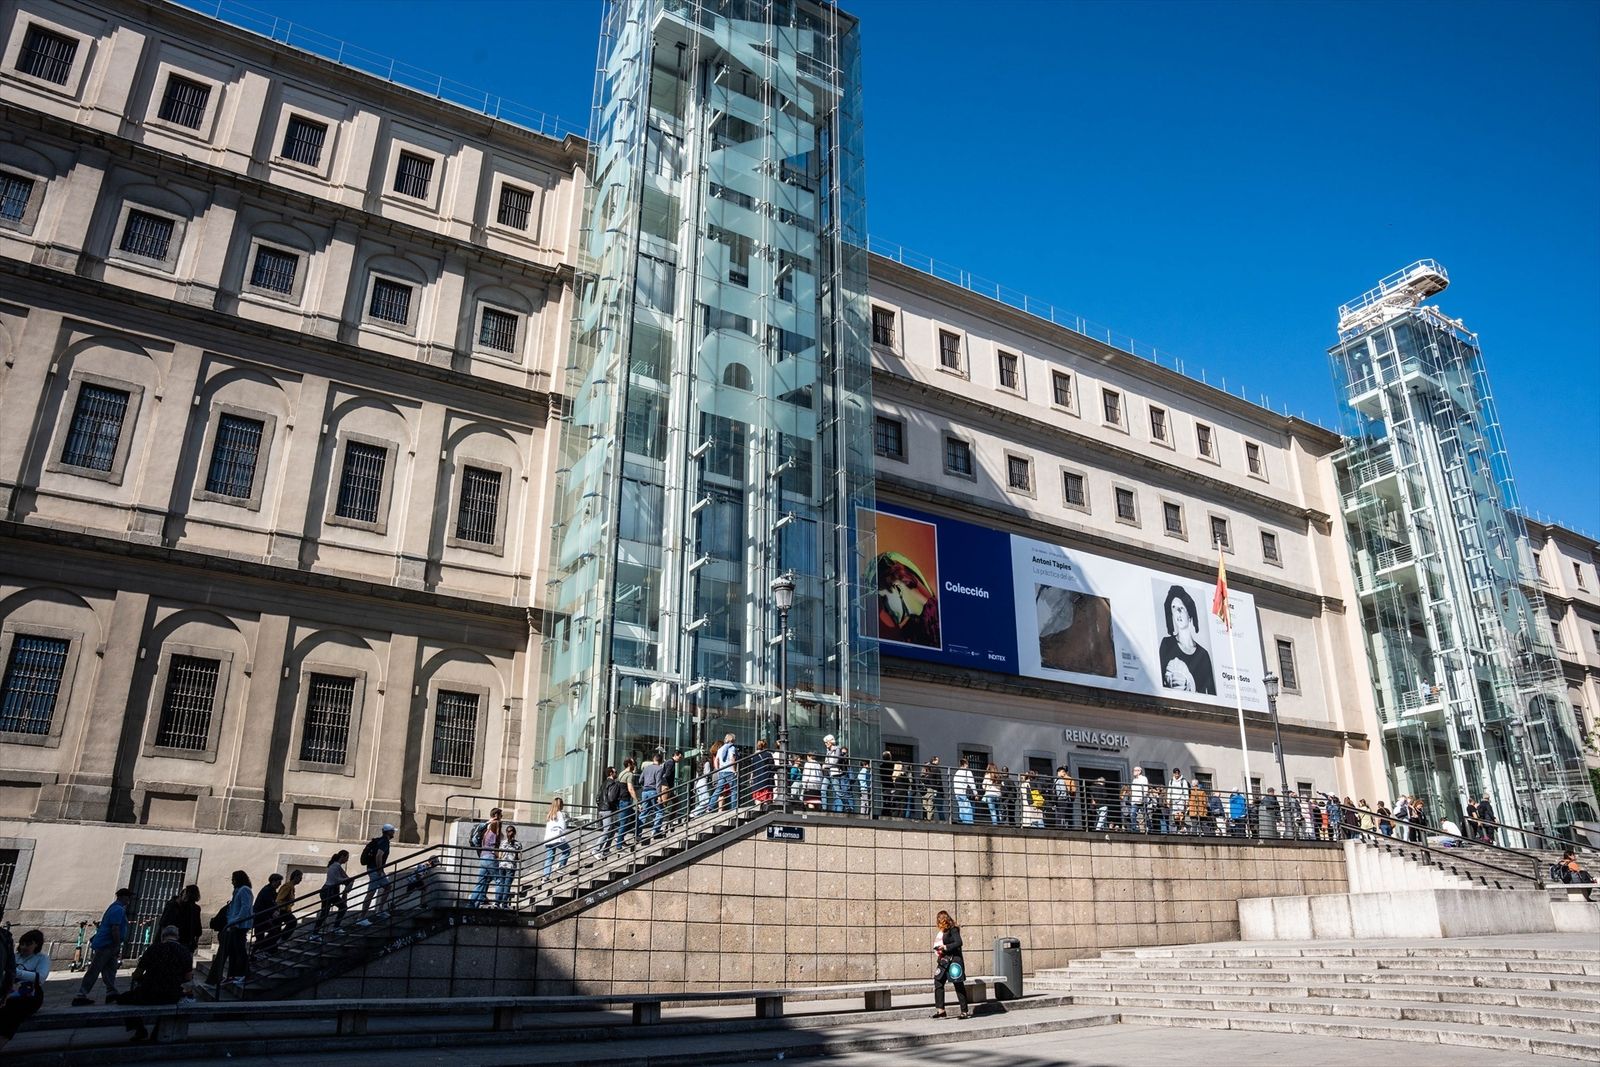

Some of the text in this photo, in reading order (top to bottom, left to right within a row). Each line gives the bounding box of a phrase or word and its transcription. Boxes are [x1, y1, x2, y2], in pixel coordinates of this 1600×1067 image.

[697, 16, 816, 441] REINA
[1032, 556, 1052, 566] Antoni
[945, 581, 989, 599] Colección
[1222, 672, 1250, 683] Olga Soto
[1065, 729, 1130, 748] REINA SOFIA
